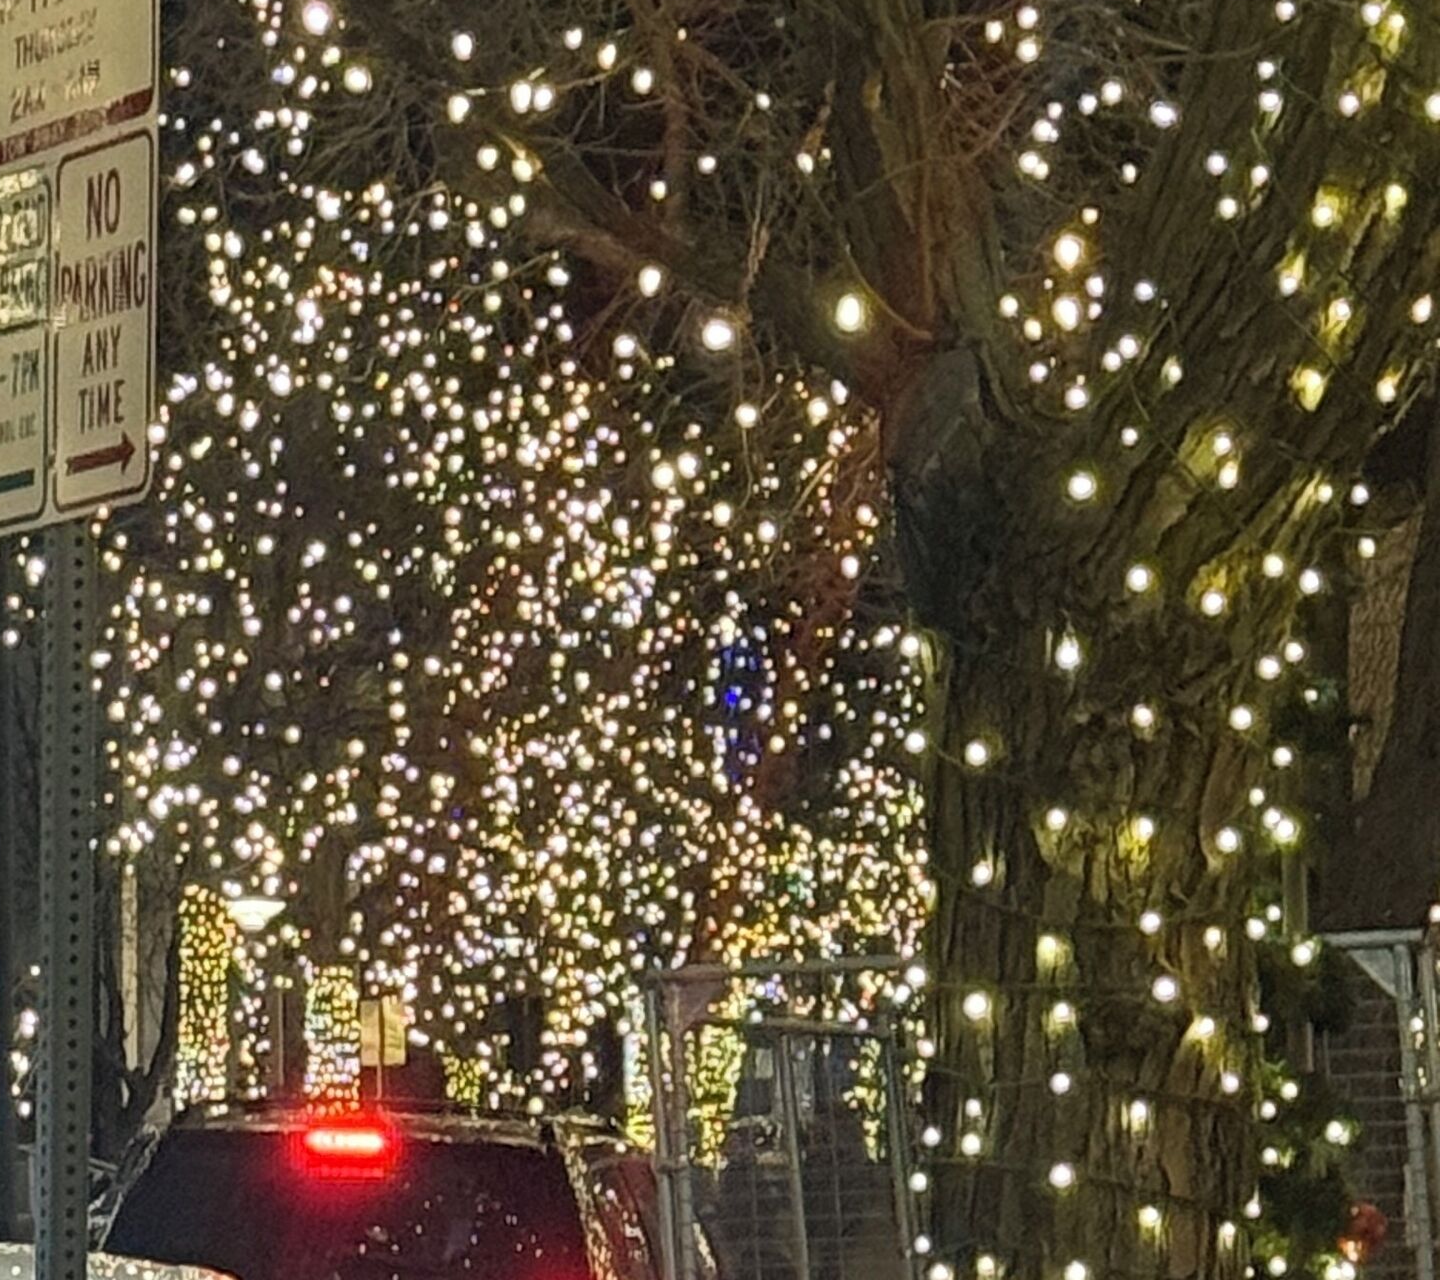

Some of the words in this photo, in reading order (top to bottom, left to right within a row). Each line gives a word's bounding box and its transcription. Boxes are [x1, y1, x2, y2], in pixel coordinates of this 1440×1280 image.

[86, 167, 121, 242] NO
[62, 239, 147, 320] PARKING
[82, 323, 122, 378] ANY
[78, 379, 125, 434] TIME
